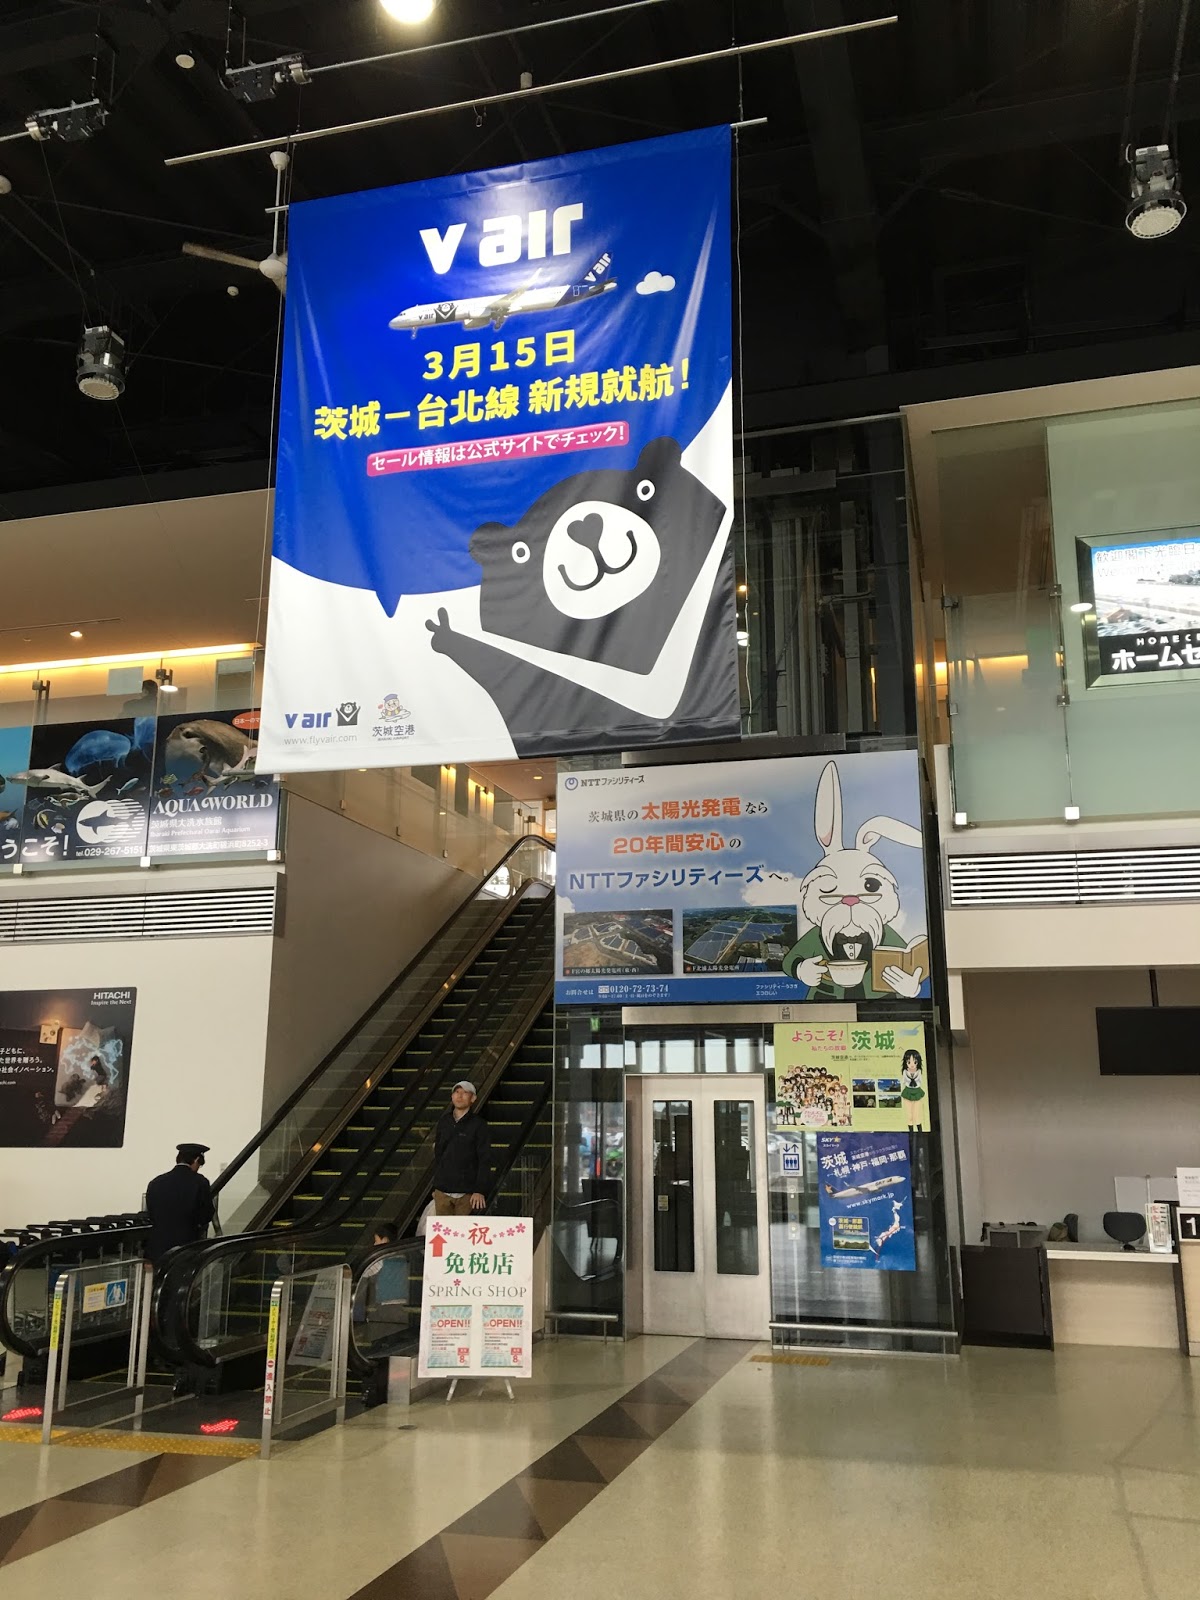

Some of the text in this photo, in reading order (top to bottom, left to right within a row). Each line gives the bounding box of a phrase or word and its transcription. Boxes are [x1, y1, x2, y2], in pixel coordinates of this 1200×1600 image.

[419, 203, 584, 275] v air
[422, 329, 575, 380] 3月15日
[371, 425, 625, 472] セール情報は公式サイトでチェック!
[1136, 634, 1180, 646] HOME
[1112, 643, 1200, 671] ホームセ
[285, 711, 332, 729] v air
[372, 724, 415, 737] 茨城空港
[284, 734, 358, 746] www.flyvair.com
[581, 775, 645, 787] NTTファシリティーズ
[152, 793, 273, 817] AQUA WORLD
[150, 816, 222, 829] 茨城県大洗水族館
[221, 826, 250, 835] Aquarium
[1, 835, 69, 859] うこそ!
[94, 991, 130, 1000] HITACHI
[610, 984, 669, 993] 0120-72-73-74
[792, 1030, 844, 1042] ようこそ!
[851, 1030, 895, 1051] 茨城
[0, 1066, 54, 1074] 社会イノベーション。
[820, 1151, 848, 1170] 茨城
[846, 1192, 894, 1209] www.skymark.jp
[468, 1222, 493, 1246] 祝
[443, 1252, 514, 1275] 免税店
[428, 1284, 527, 1298] SPRING SHOP
[264, 1372, 273, 1416] 進入禁止
